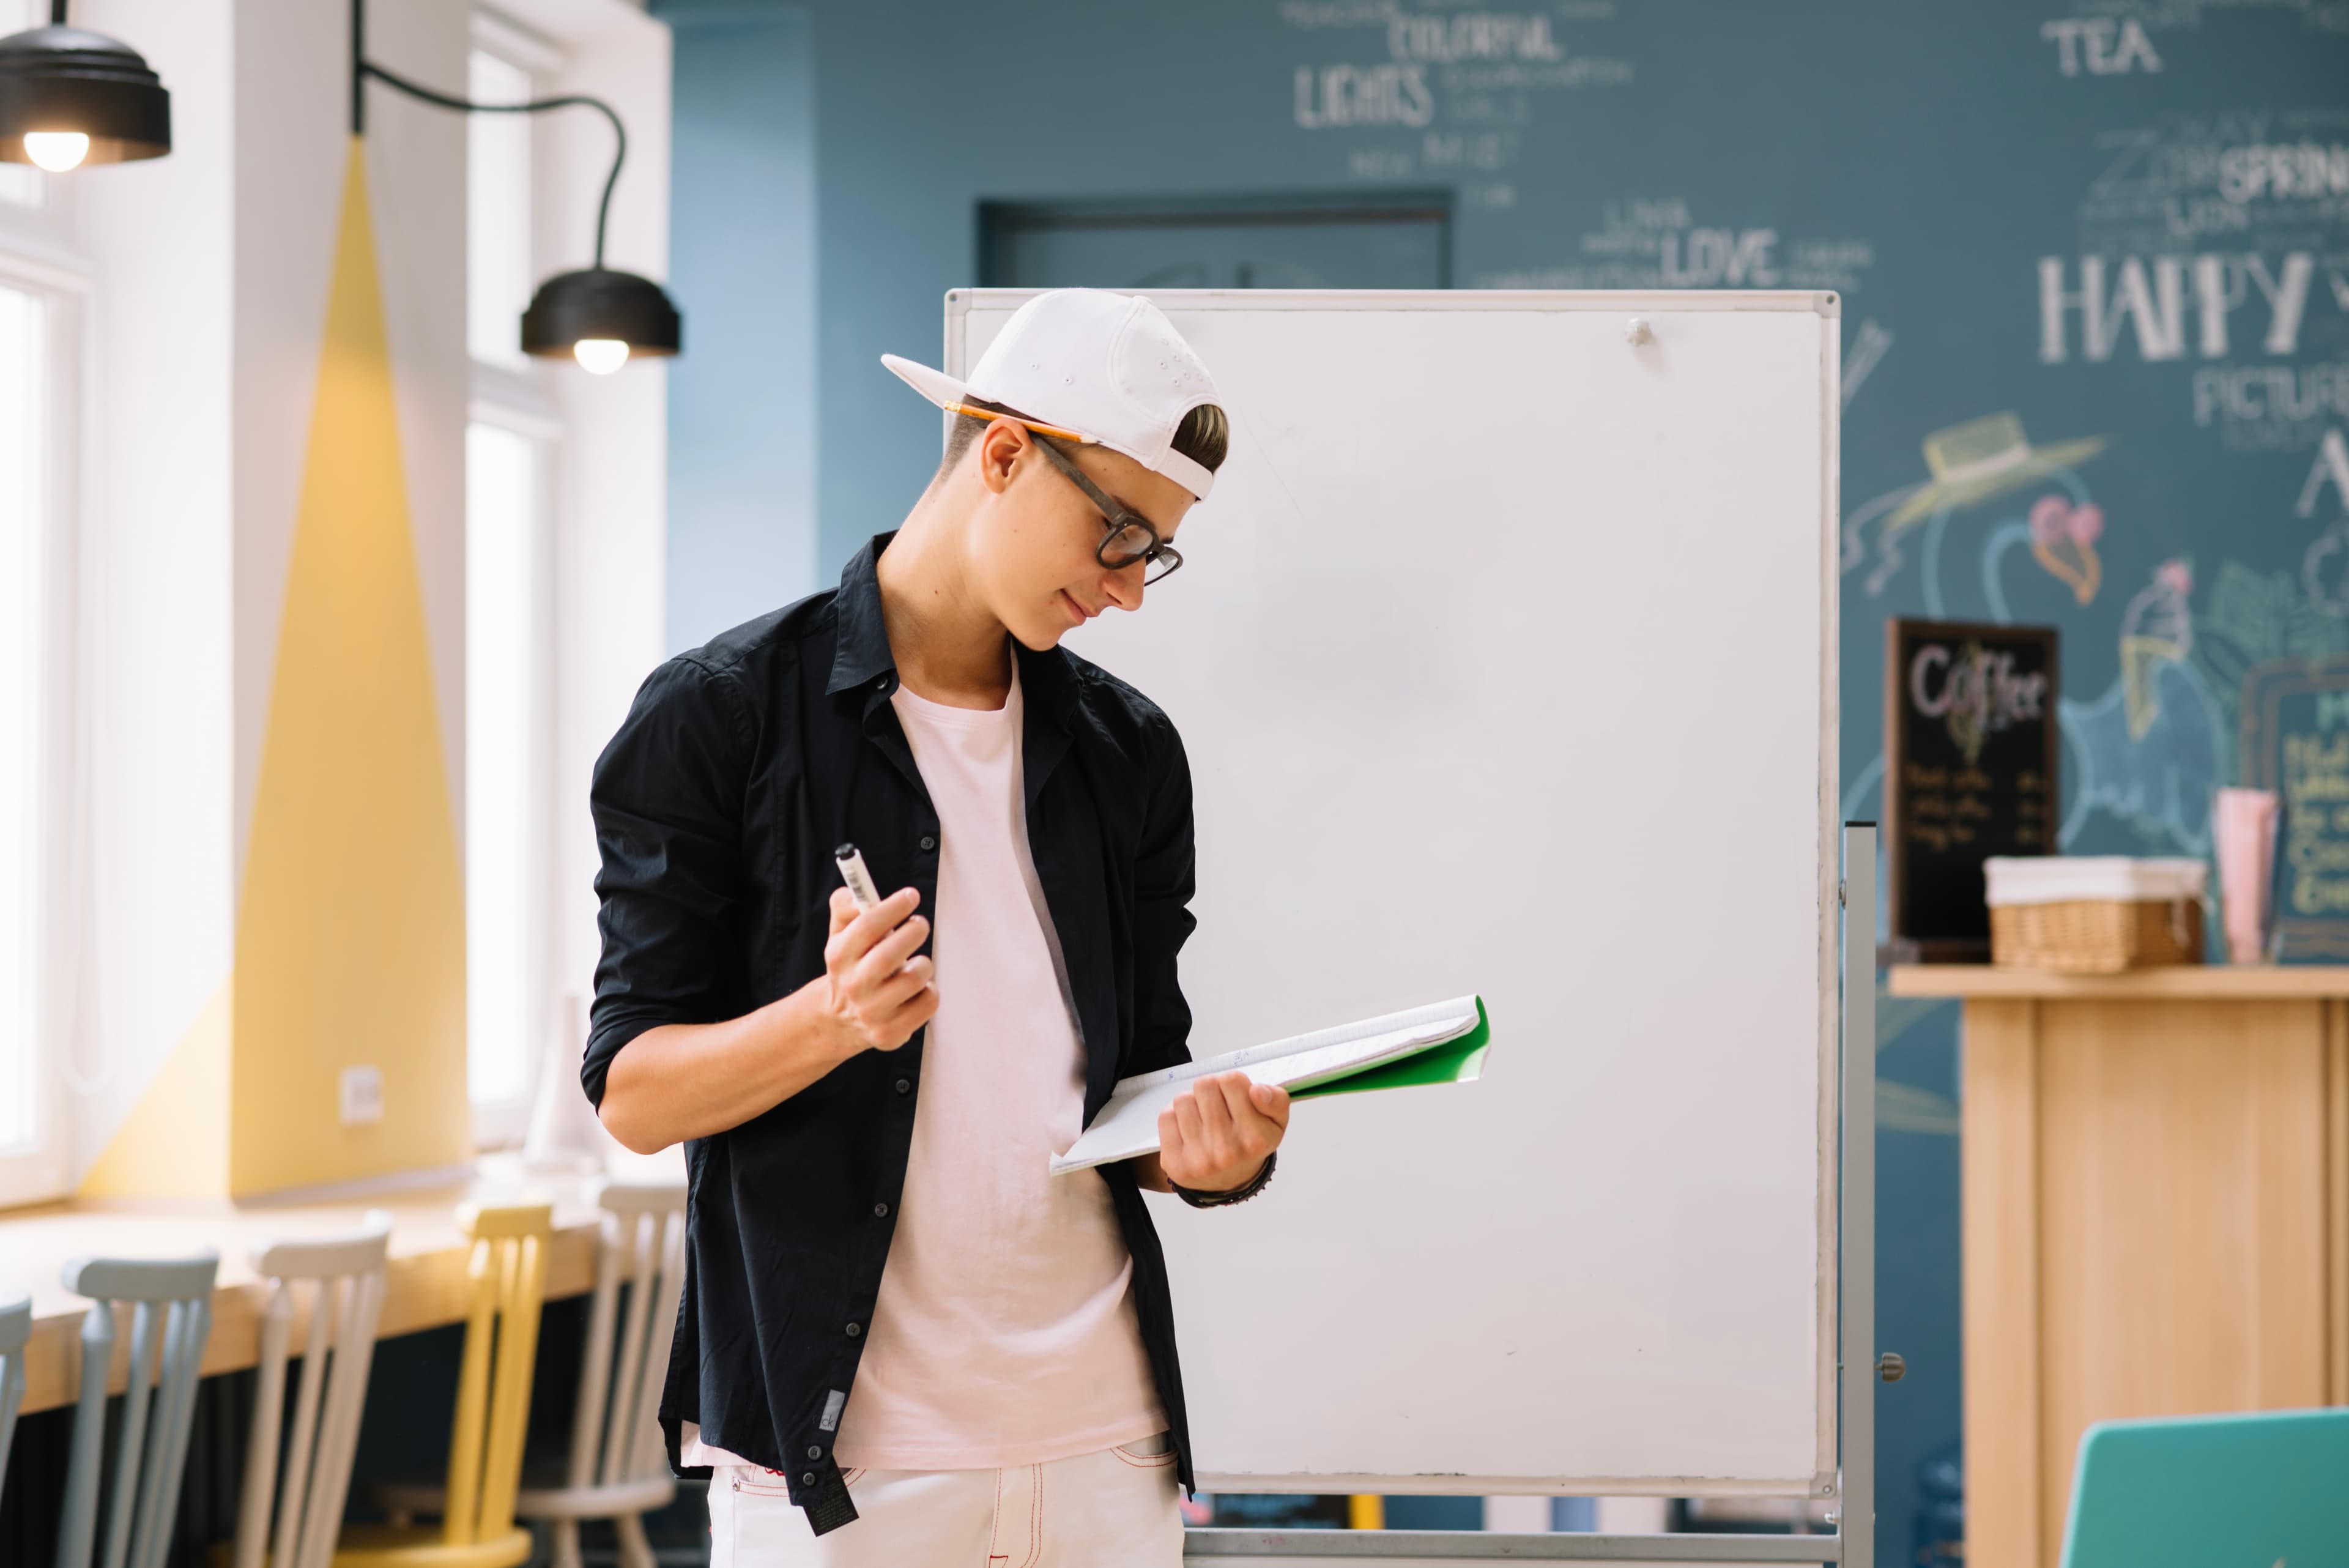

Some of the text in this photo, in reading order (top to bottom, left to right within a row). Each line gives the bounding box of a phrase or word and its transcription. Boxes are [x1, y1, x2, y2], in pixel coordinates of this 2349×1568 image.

[2041, 18, 2162, 76] TEA
[1294, 64, 1433, 127] LIGHTS
[1661, 228, 1779, 287] LOVE
[2040, 252, 2313, 362] HAPPY
[1911, 644, 2044, 731] Coffee
[822, 1414, 833, 1427] ck
